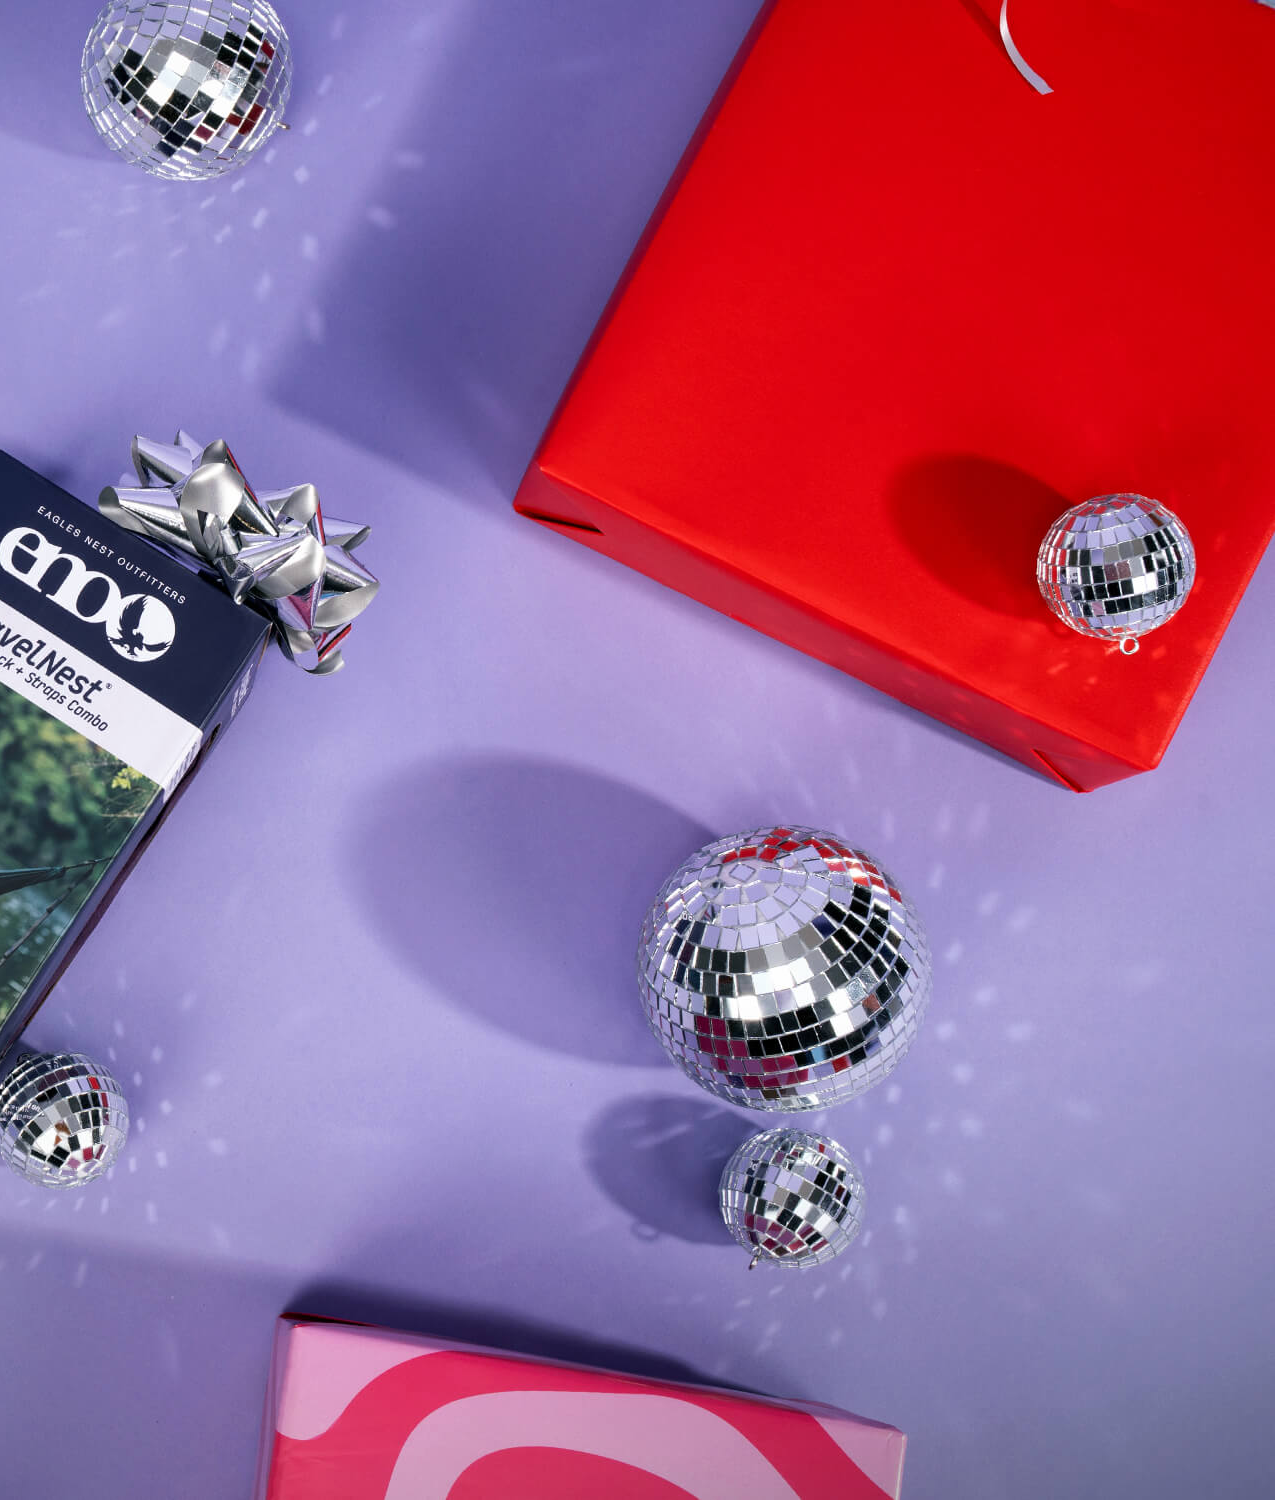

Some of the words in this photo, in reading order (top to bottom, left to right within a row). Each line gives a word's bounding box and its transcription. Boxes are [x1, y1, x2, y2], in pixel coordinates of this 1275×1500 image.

[37, 506, 81, 537] EAGLES
[84, 536, 114, 557] NEST
[117, 557, 185, 604] OUTFITTERS
[15, 666, 24, 675] +
[24, 672, 67, 704] Straps
[67, 700, 108, 731] Combo
